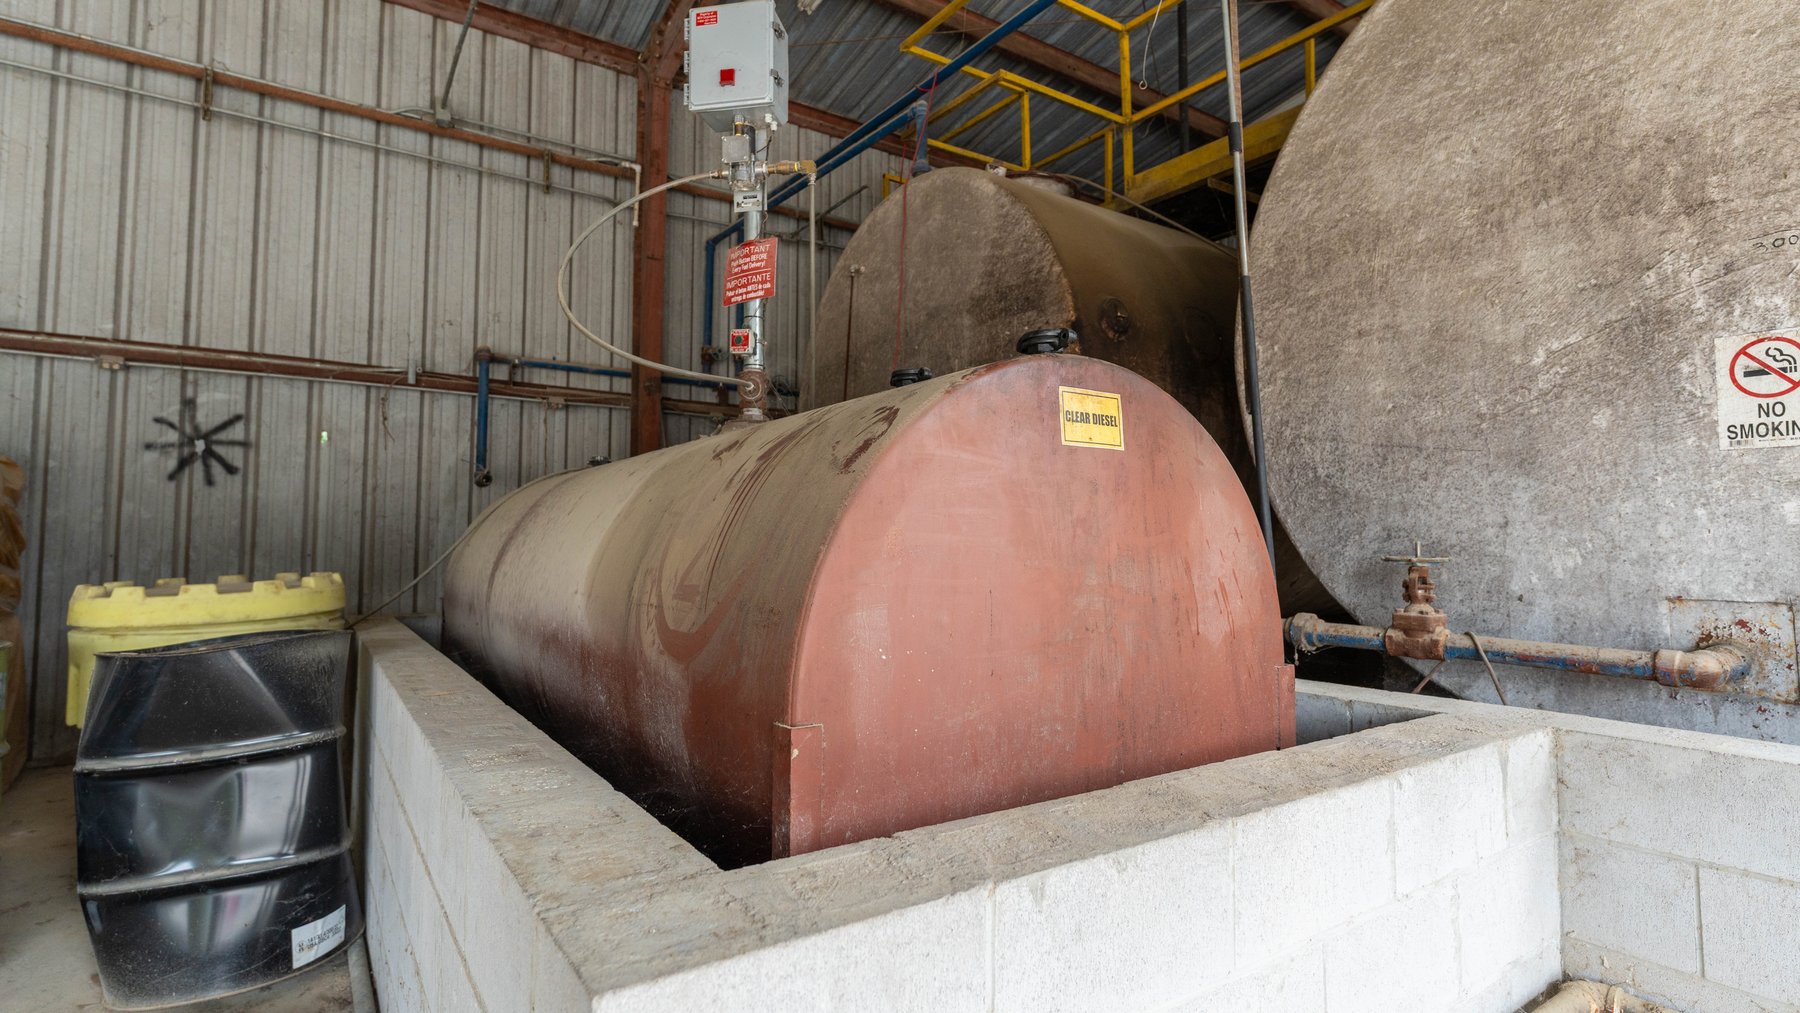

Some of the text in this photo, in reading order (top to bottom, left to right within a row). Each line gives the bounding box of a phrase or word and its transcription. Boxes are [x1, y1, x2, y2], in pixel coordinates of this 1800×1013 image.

[731, 244, 770, 259] IMPORTANT
[750, 253, 767, 261] BEFORE
[749, 260, 766, 269] Delivery!
[726, 272, 771, 288] IMPORTANTE
[747, 283, 758, 291] ANTES
[1758, 401, 1786, 418] NO
[1065, 410, 1118, 427] CLEAR DIESEL
